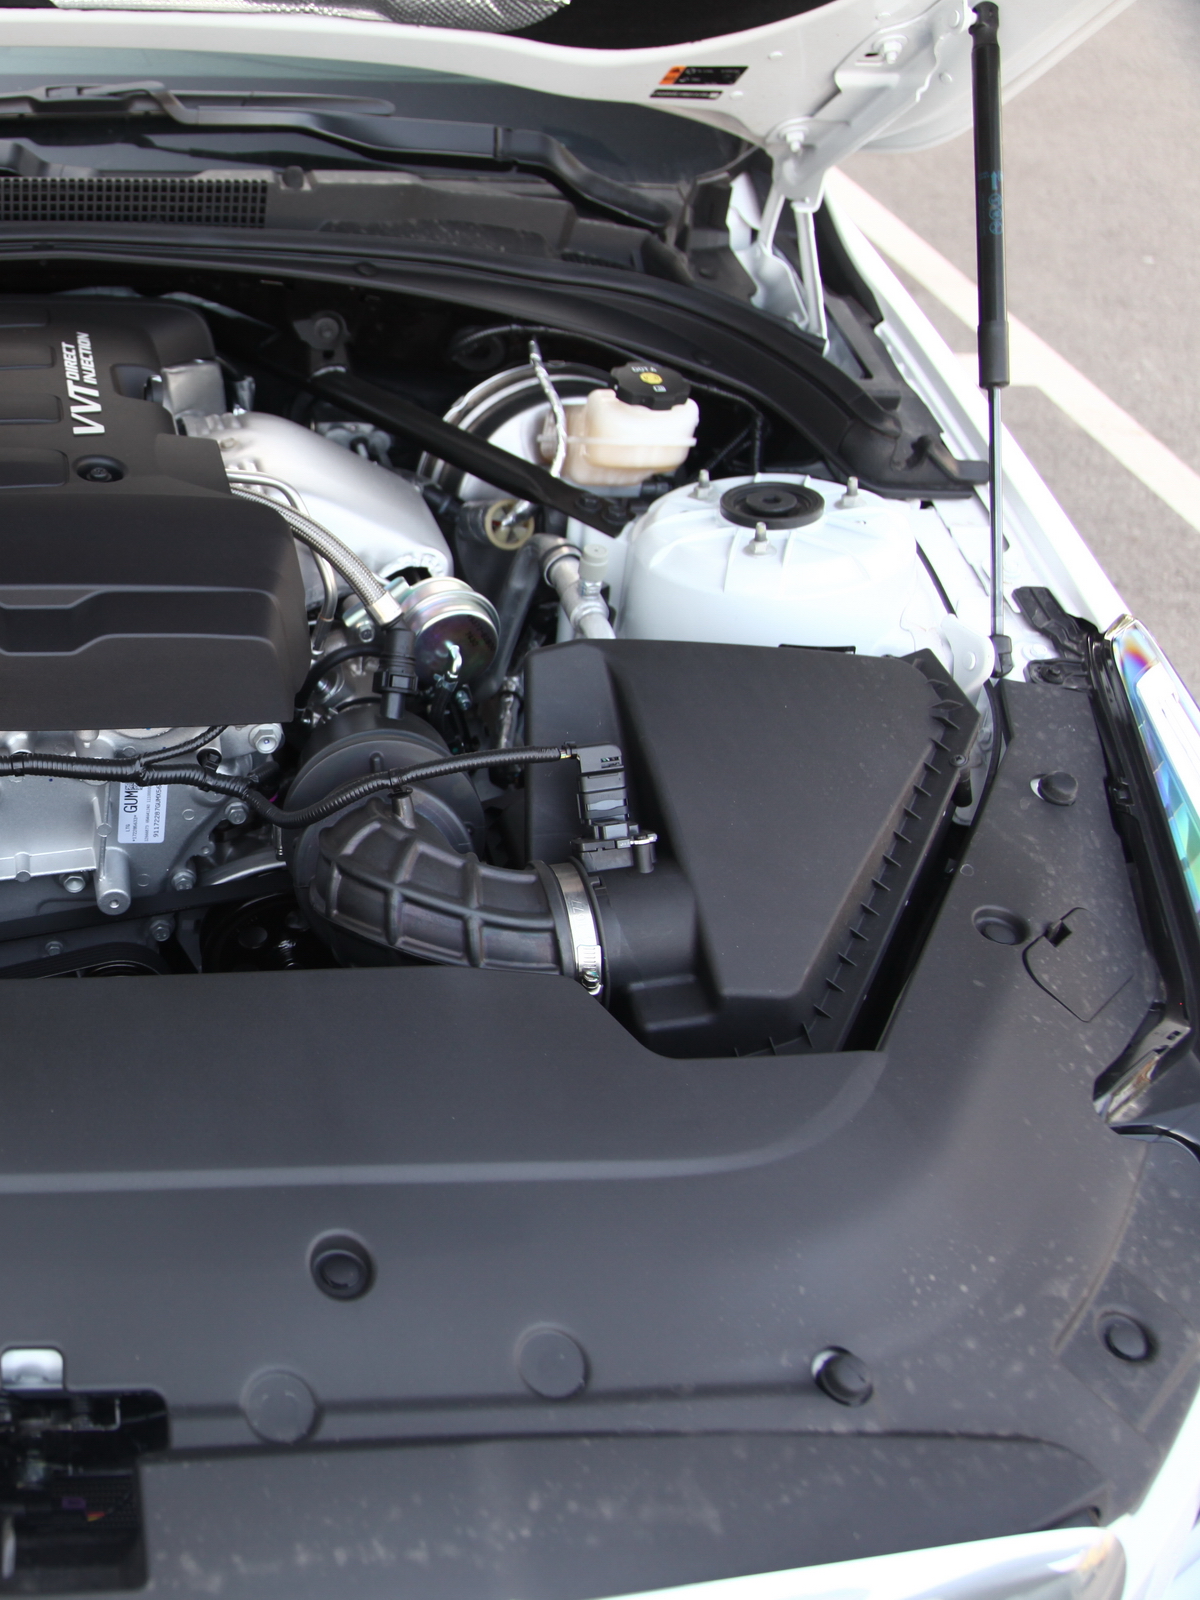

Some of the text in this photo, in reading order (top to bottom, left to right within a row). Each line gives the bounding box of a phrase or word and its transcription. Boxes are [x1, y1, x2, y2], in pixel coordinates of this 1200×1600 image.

[61, 341, 80, 381] DIRECT
[76, 331, 97, 385] INJECTION
[66, 379, 105, 435] VVT
[123, 790, 138, 813] GUM
